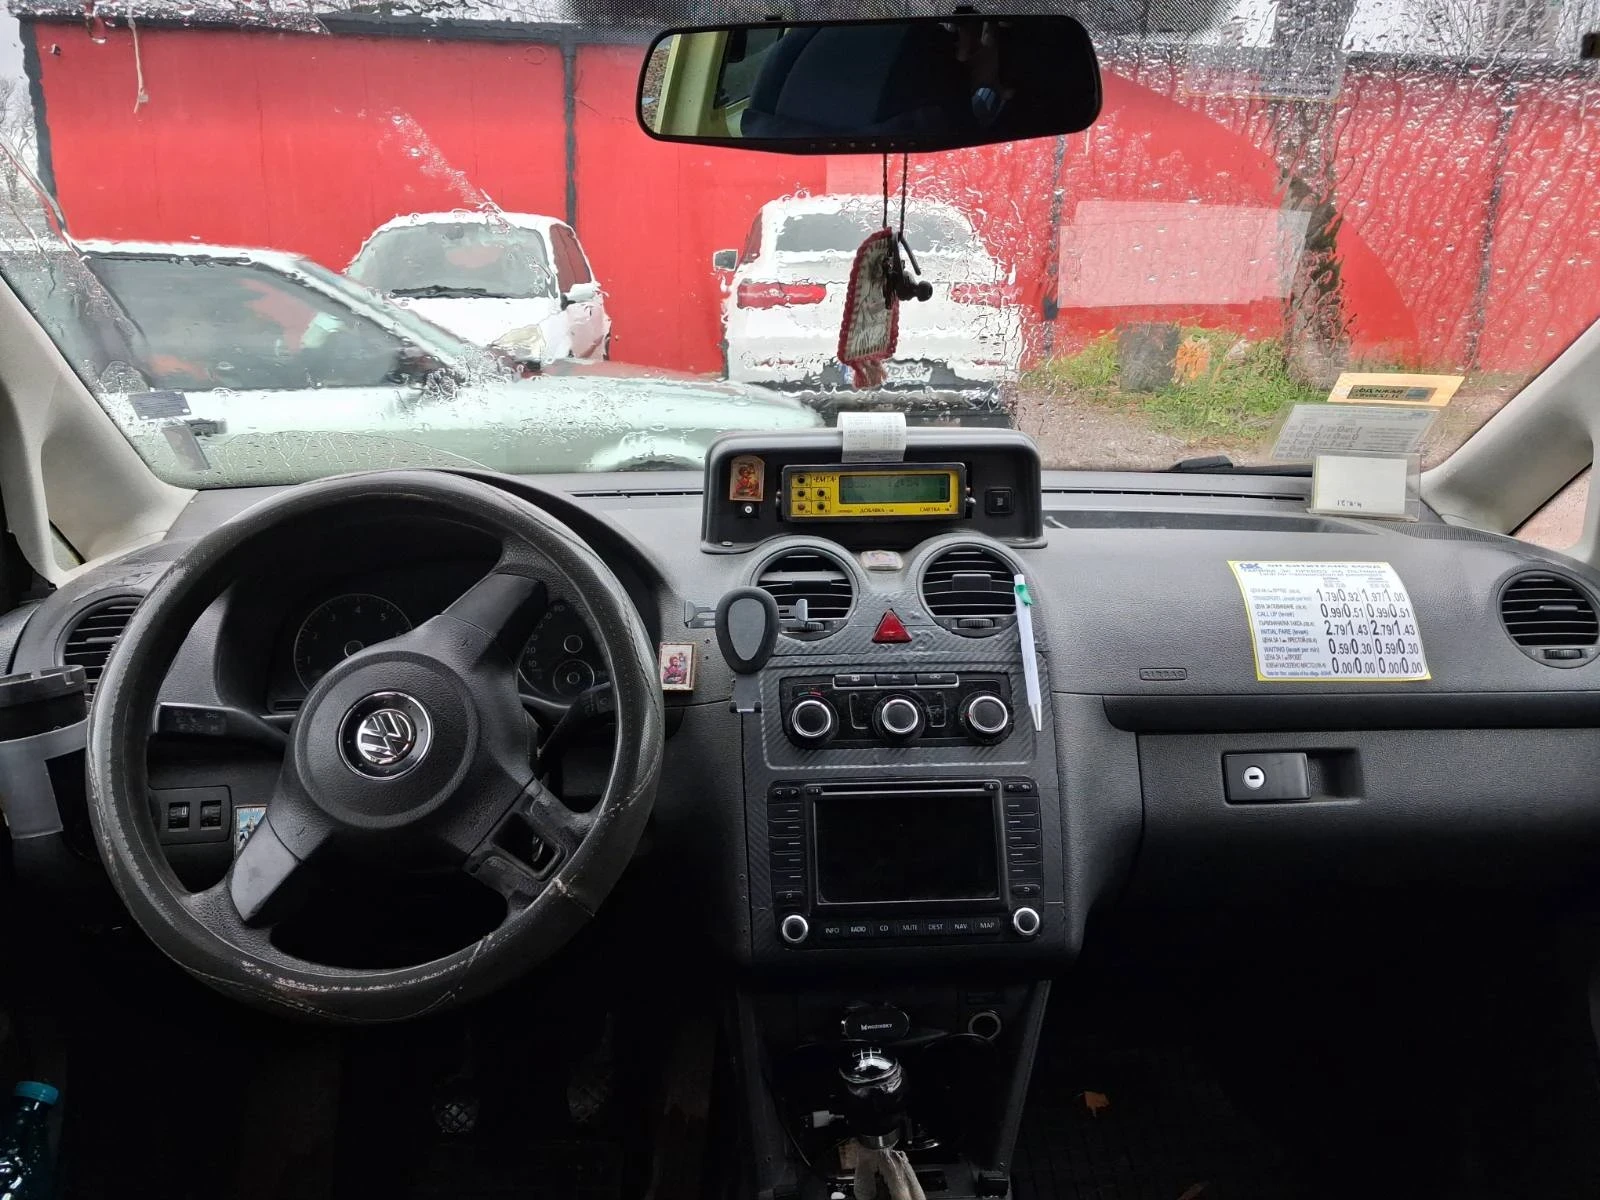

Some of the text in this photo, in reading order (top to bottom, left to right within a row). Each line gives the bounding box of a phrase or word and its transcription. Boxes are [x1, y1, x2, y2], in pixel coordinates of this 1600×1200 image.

[1320, 603, 1410, 618] 0.99/0.51 0.99/0.51
[1324, 620, 1368, 636] 2.79/1.43
[1370, 620, 1415, 636] 2.79/1.43
[1328, 638, 1419, 655] 0.59/0.30 0.59/0.30
[1332, 657, 1423, 674] 0.00/0.00 0.00/0.00
